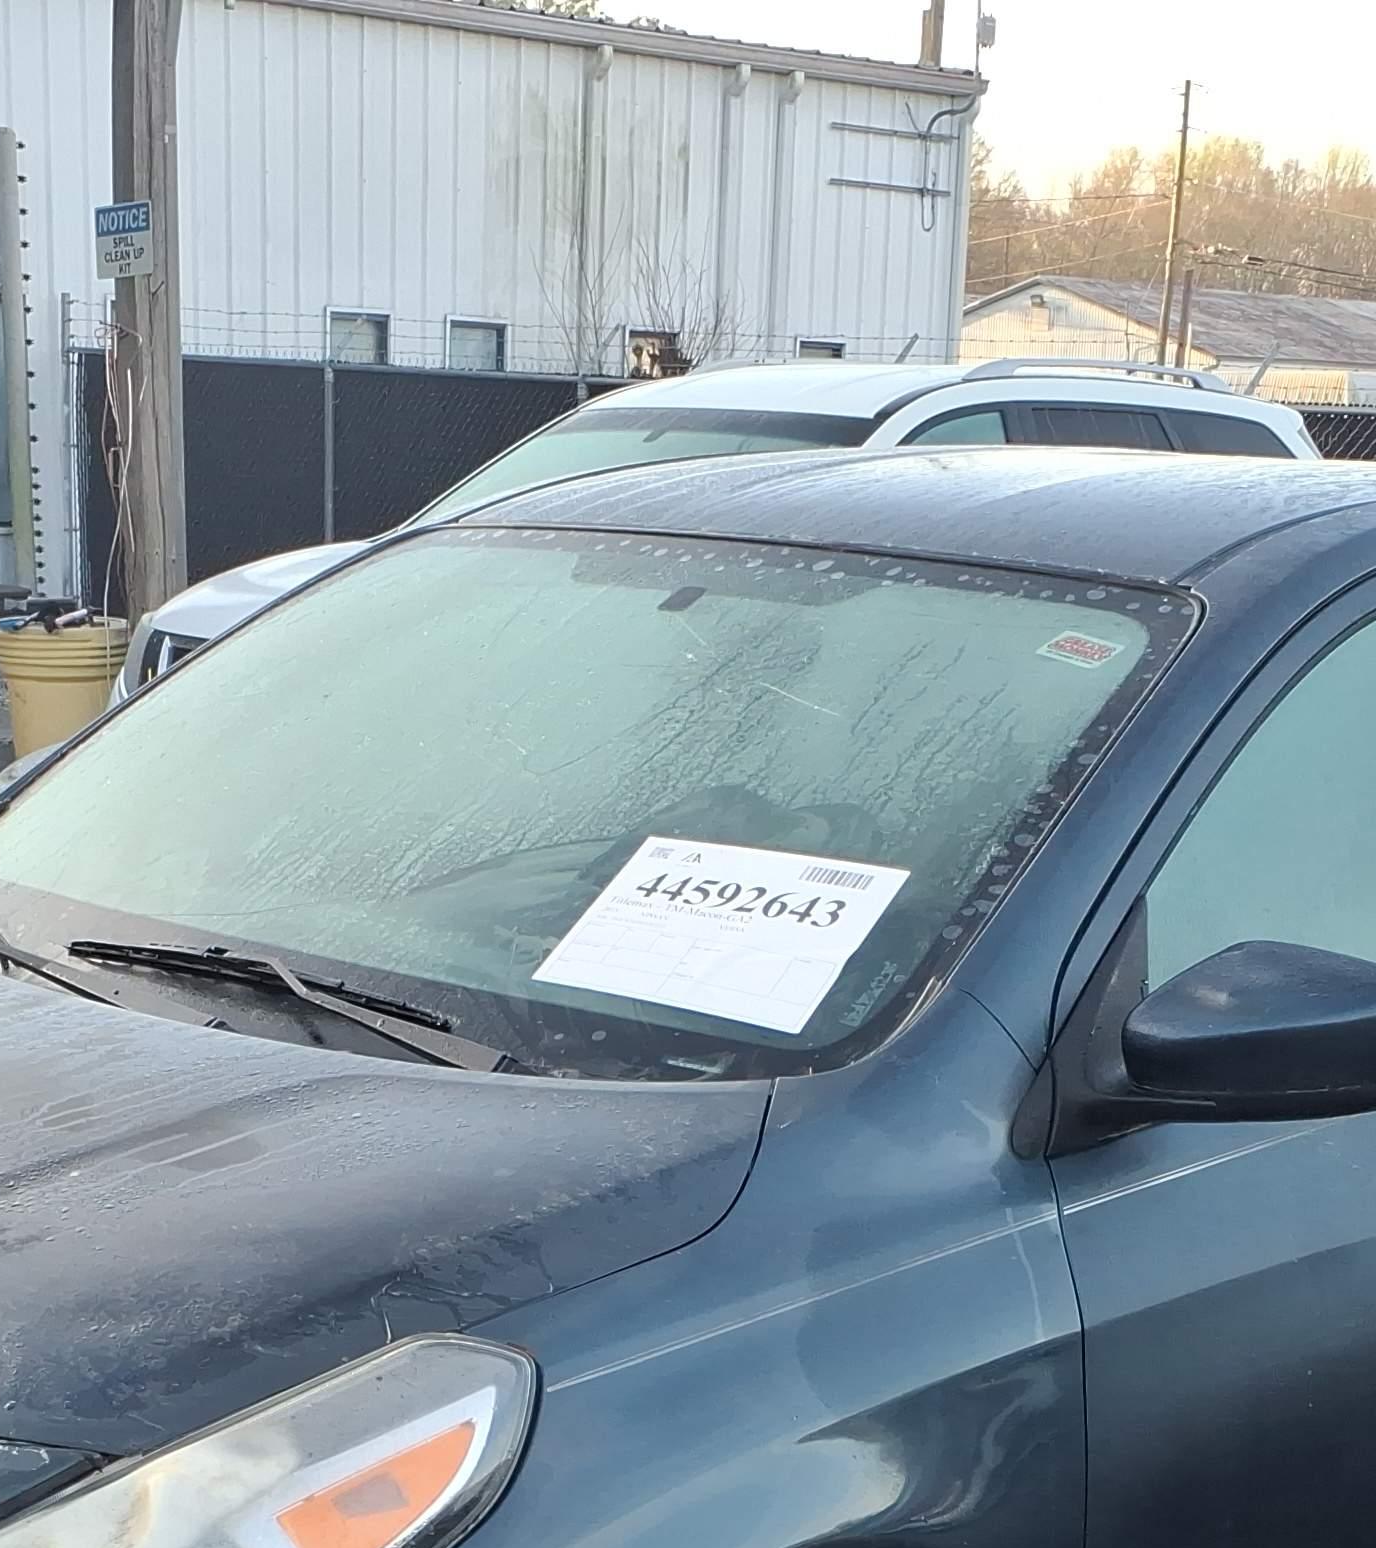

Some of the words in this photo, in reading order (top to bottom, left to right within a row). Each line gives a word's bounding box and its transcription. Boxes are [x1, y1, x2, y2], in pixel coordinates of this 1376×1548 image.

[98, 207, 148, 233] NOTICE
[112, 235, 135, 249] SPILL
[104, 249, 131, 263] CLEAN
[133, 247, 145, 260] UP
[118, 263, 131, 275] KIT
[636, 872, 847, 928] 44592643
